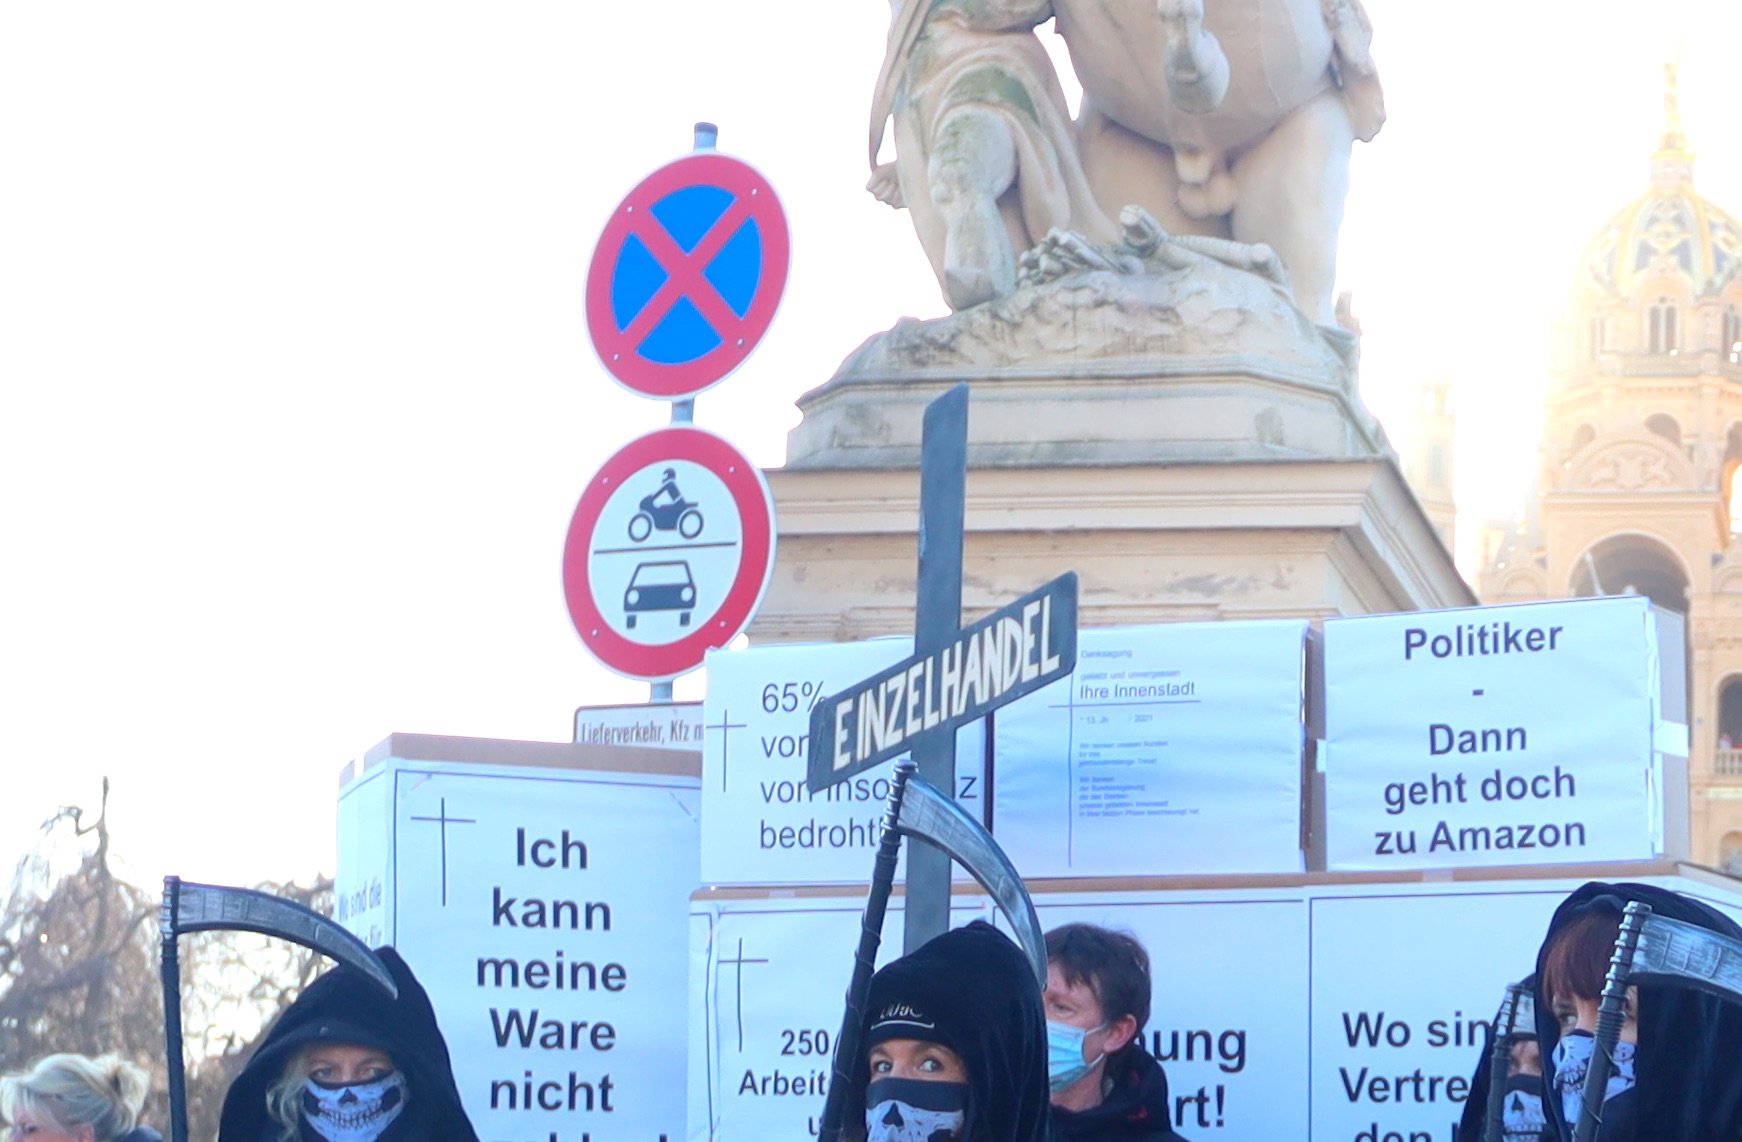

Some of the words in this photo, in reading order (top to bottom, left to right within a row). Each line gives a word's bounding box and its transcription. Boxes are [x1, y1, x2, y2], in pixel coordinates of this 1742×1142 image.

[1405, 622, 1563, 660] Politiker
[832, 595, 1060, 772] EINZELHANDEL
[1080, 685, 1109, 699] Ihre
[1114, 681, 1195, 698] Innenstadt
[670, 719, 690, 742] Kfz
[1429, 723, 1527, 755] Dann
[1384, 772, 1468, 815] geht
[1481, 765, 1576, 802] doch
[516, 827, 588, 870] Ich
[760, 818, 882, 849] bedroht
[1375, 830, 1416, 855] zu
[1429, 820, 1586, 853] Amazon
[492, 886, 611, 931] kann
[477, 950, 628, 992] meine
[488, 1008, 617, 1051] Ware
[781, 1029, 829, 1056] 250
[1342, 1011, 1411, 1048] Wo
[490, 1070, 615, 1112] nicht
[738, 1069, 831, 1097] Arbeit
[1175, 1084, 1225, 1128] rt!
